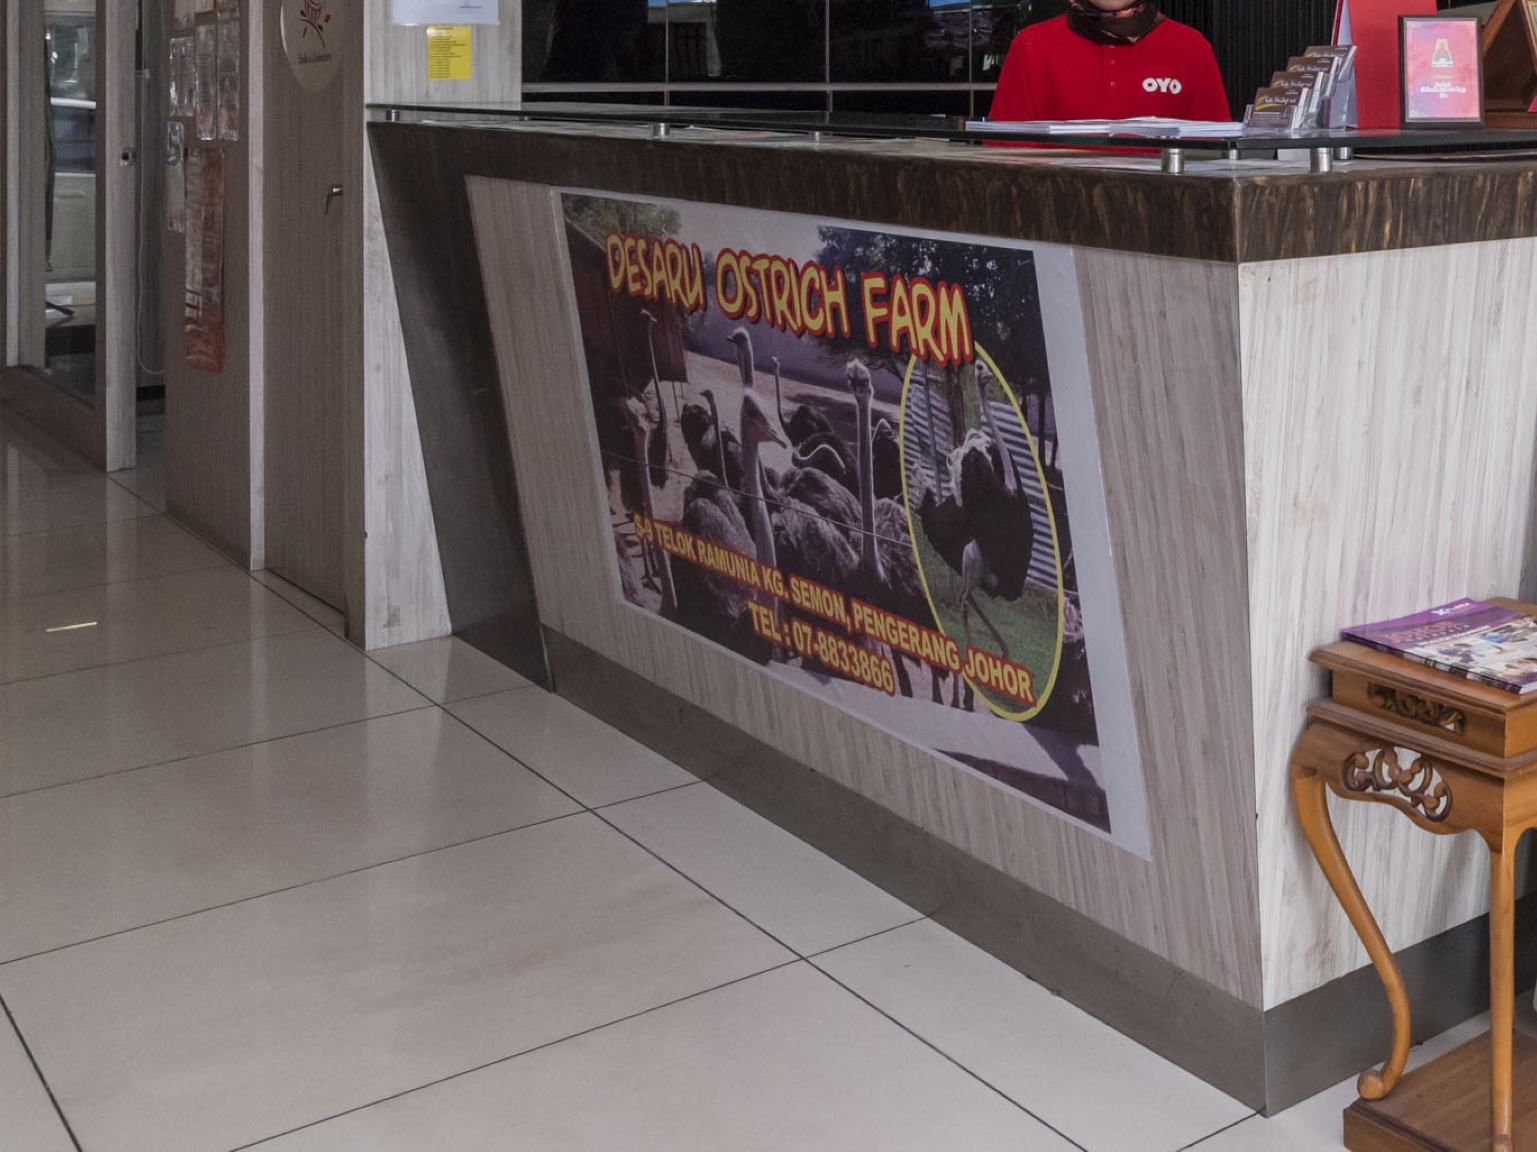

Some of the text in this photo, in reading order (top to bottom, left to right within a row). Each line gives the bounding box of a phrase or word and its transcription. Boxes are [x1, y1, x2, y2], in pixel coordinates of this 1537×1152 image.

[1142, 77, 1182, 95] OYO
[606, 230, 974, 367] DESARU OSTRICH FARM
[653, 521, 697, 562] TELOK
[697, 538, 761, 588] RAMUNIA
[761, 564, 790, 600] KG.
[789, 573, 851, 633] SEMON,
[852, 599, 963, 675] PENGERANG
[963, 644, 1037, 706] JOHOR
[748, 602, 782, 643] TEL
[791, 619, 896, 696] 07-8833866
